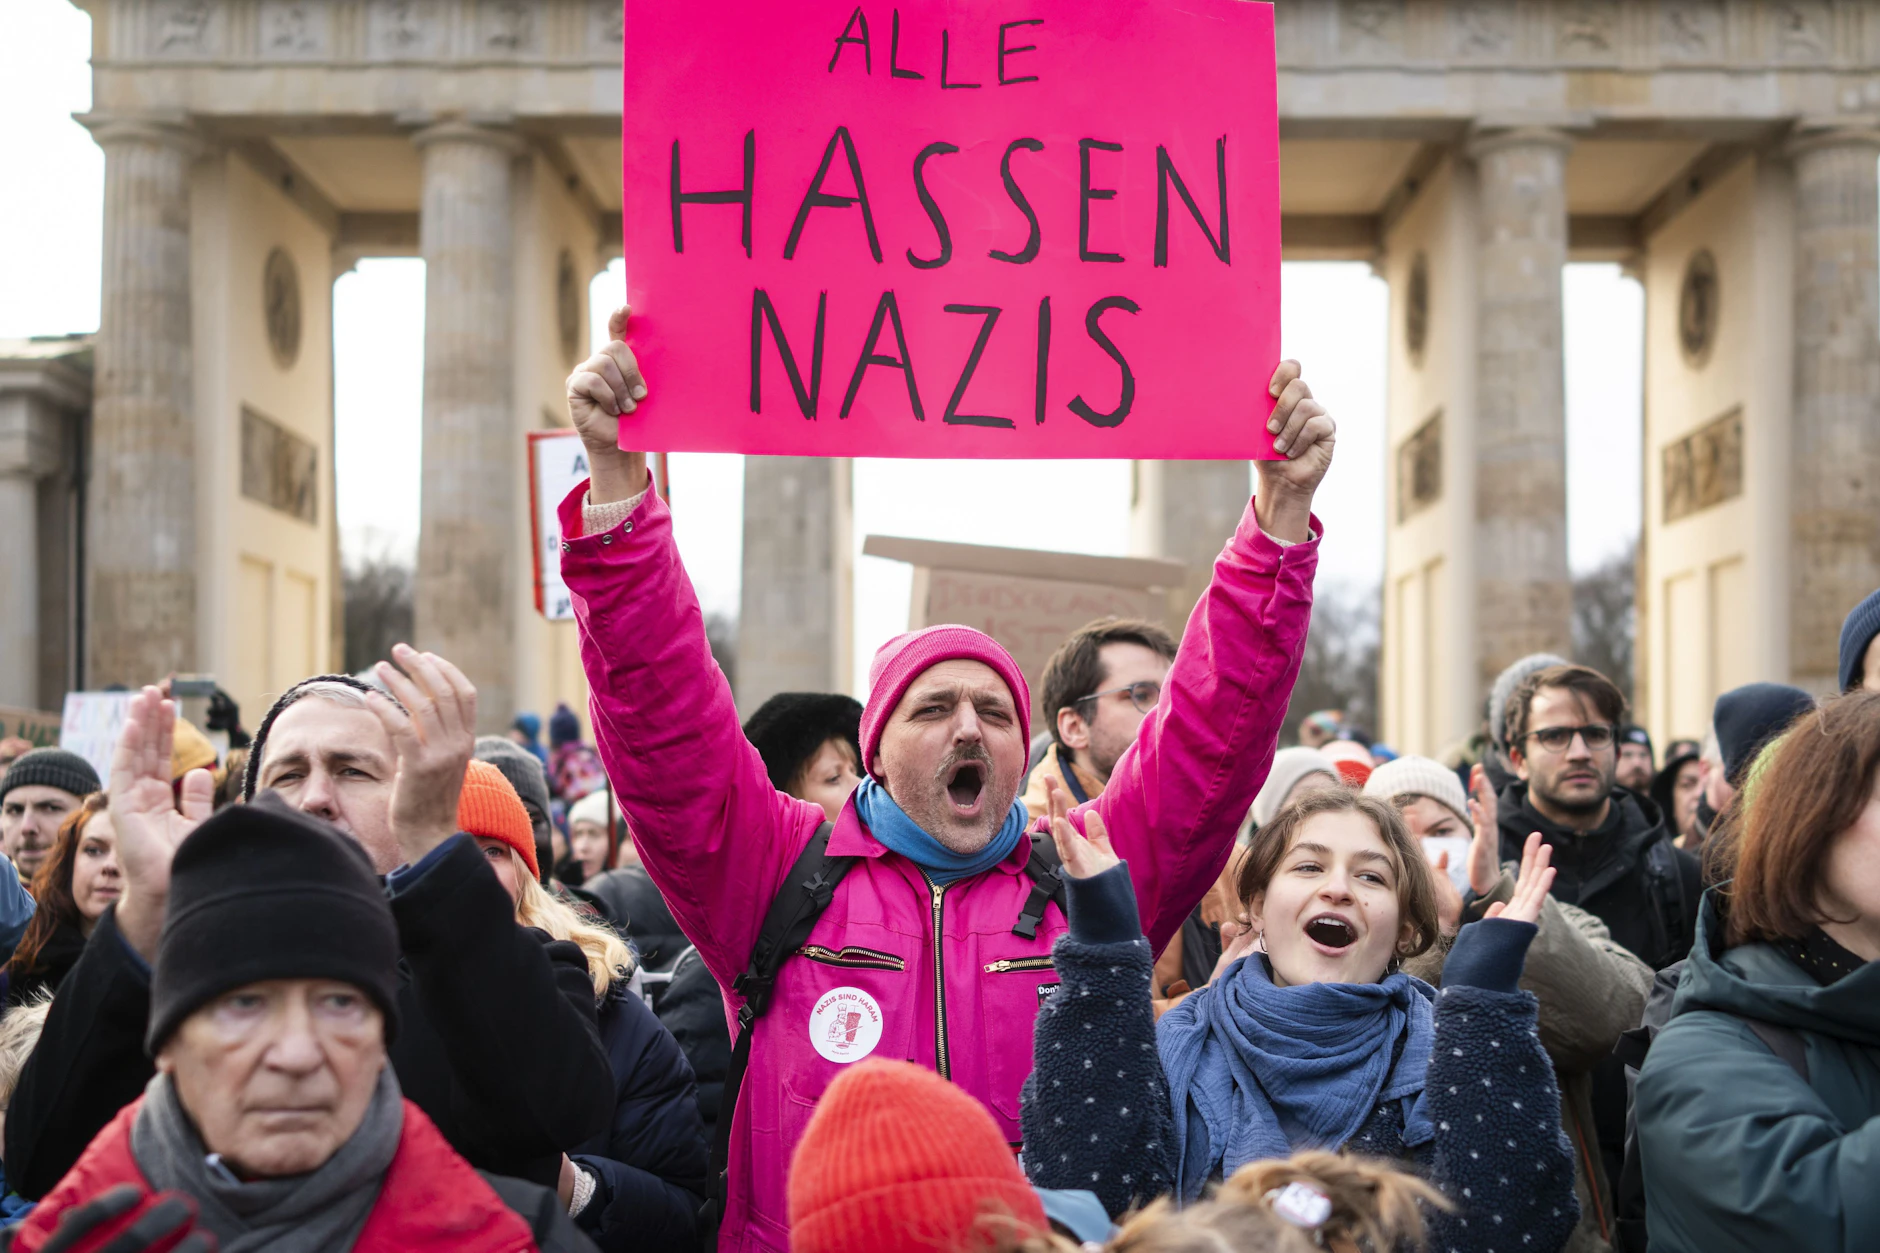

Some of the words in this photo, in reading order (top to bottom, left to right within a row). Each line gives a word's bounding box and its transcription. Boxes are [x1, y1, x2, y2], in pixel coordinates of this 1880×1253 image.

[828, 6, 1045, 89] ALLE
[670, 125, 1231, 270] HASSEN
[749, 288, 1142, 429] NAZIS
[816, 996, 837, 1015] NAZIS
[838, 993, 857, 1001] SIND
[858, 997, 878, 1023] HARAM
